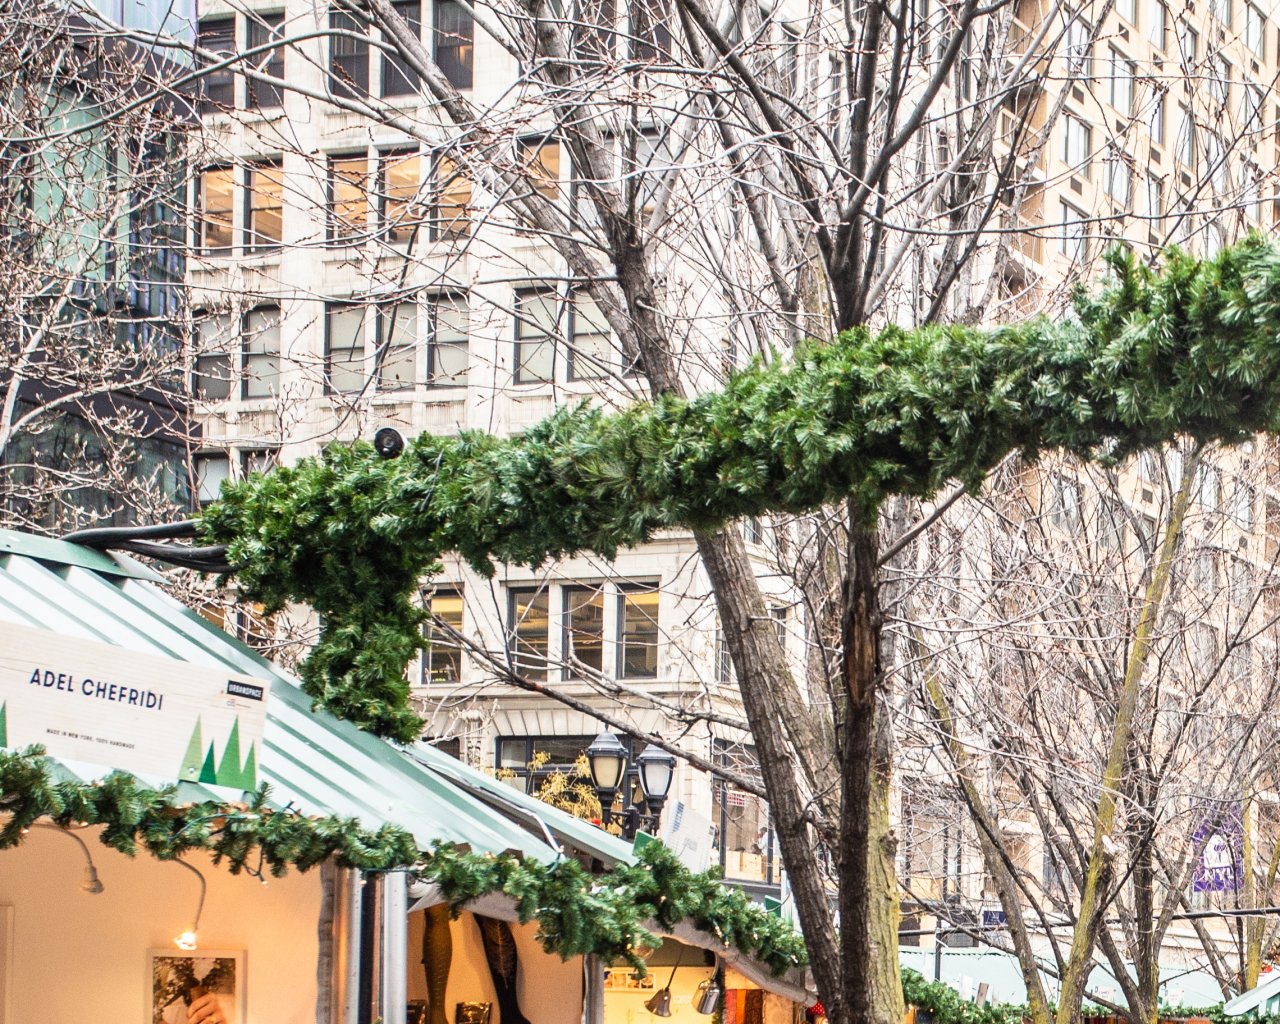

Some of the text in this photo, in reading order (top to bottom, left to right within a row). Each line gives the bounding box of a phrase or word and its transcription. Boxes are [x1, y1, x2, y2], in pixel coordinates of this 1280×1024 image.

[30, 668, 164, 711] ADEL CHEFRIDI
[46, 728, 60, 736] MADE
[109, 740, 135, 749] HANDMADE
